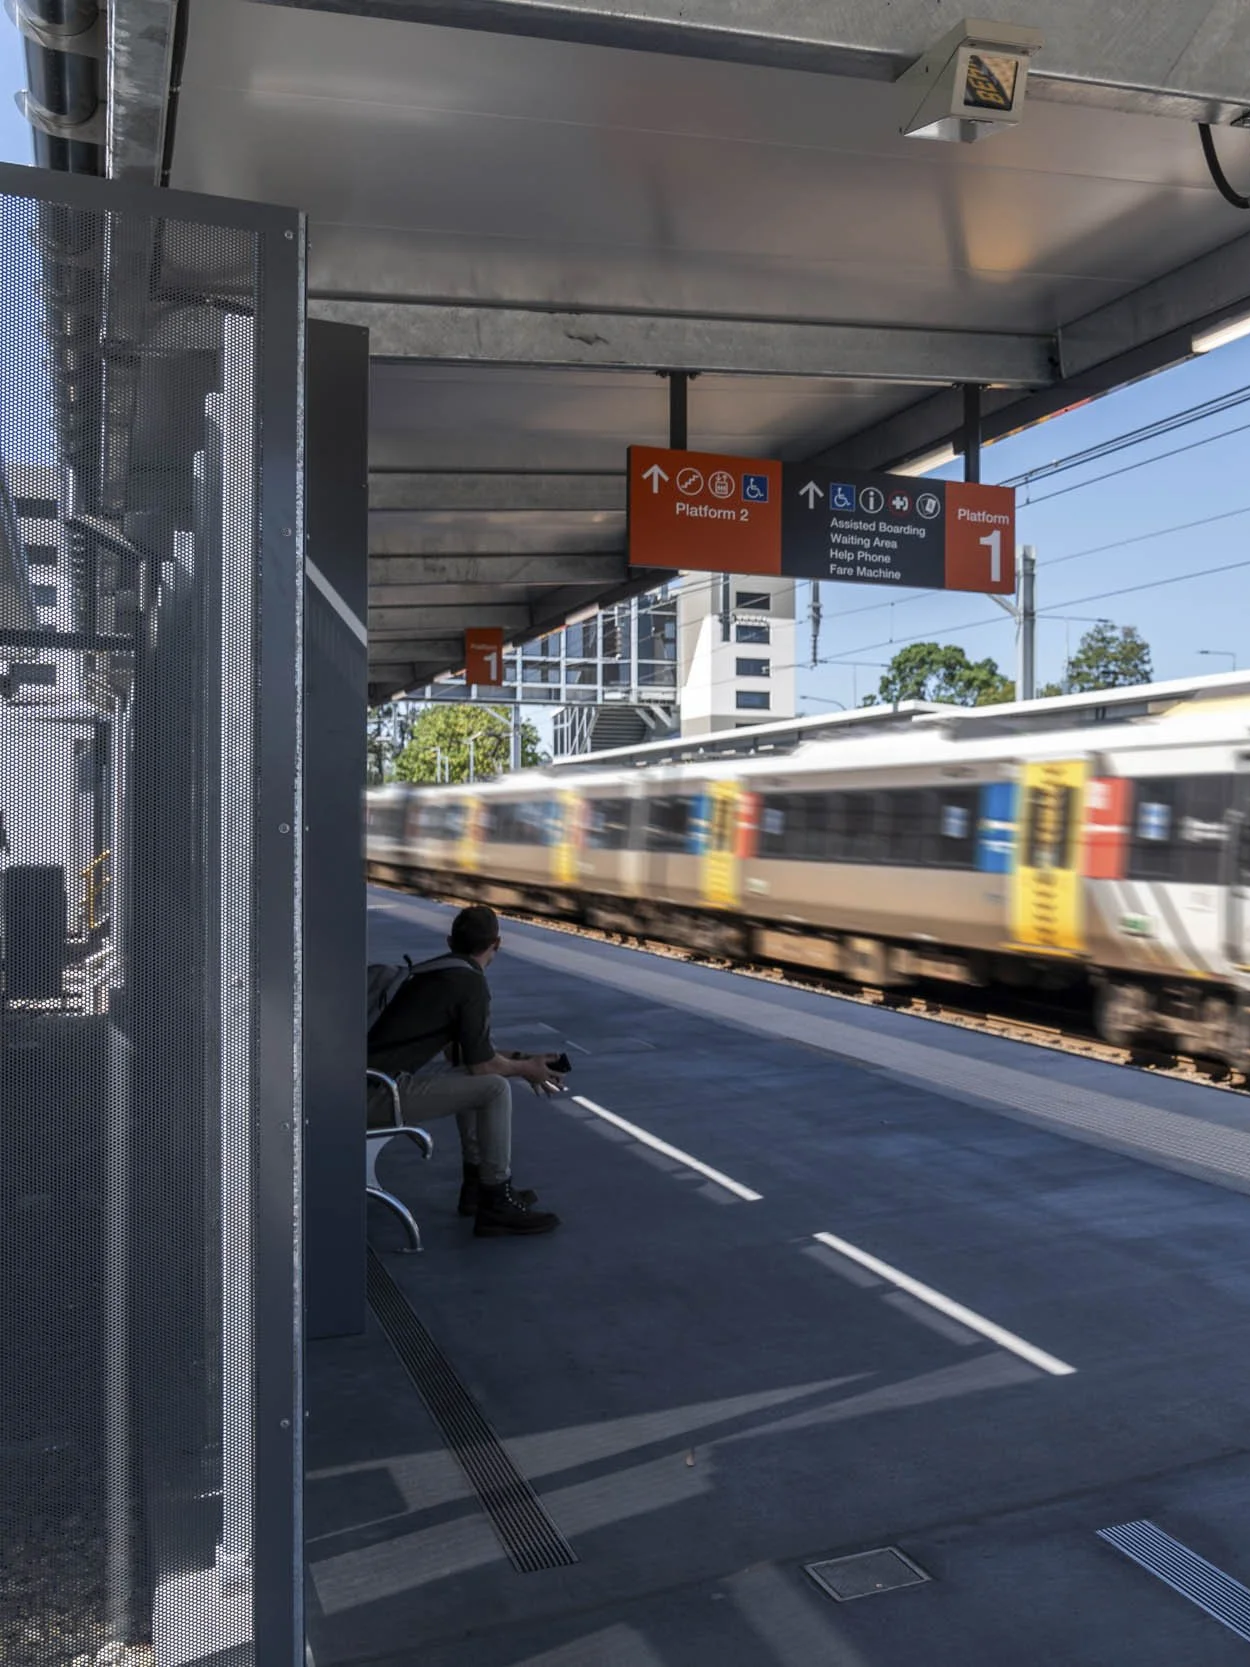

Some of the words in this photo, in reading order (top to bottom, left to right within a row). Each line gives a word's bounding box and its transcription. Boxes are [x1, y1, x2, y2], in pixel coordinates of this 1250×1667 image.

[675, 501, 737, 521] Platform
[740, 508, 749, 522] 2
[957, 507, 1010, 525] Platform
[830, 517, 876, 532] Assisted
[878, 521, 926, 539] Boarding
[830, 532, 871, 549] Waiting
[872, 537, 898, 549] Area
[829, 548, 855, 562] Help
[857, 551, 892, 564] Phone
[979, 529, 1001, 582] 1
[829, 563, 854, 576] Fare
[856, 566, 901, 580] Machine
[483, 652, 498, 681] 1
